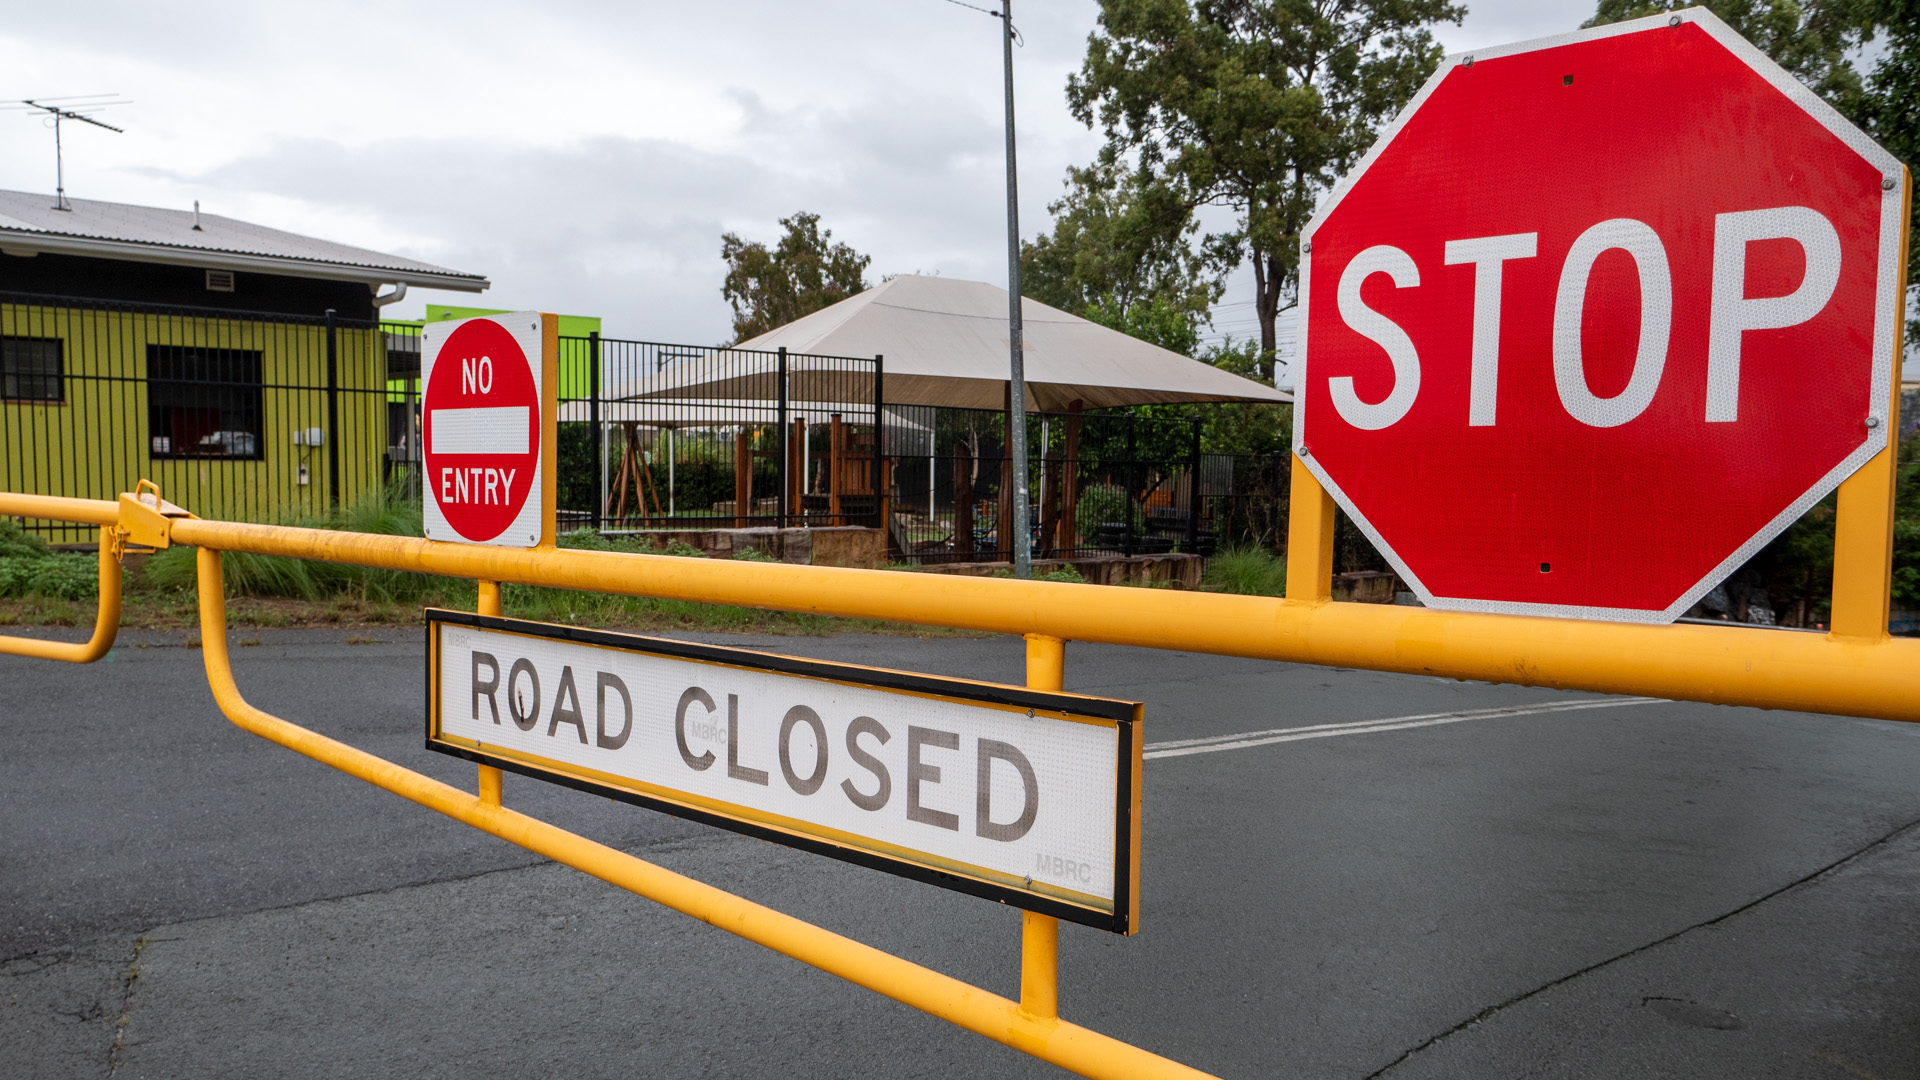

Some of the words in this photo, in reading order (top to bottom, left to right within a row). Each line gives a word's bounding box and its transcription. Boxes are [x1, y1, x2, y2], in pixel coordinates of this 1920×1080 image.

[1328, 205, 1842, 431] STOP
[462, 356, 493, 395] NO
[441, 467, 516, 506] ENTRY
[448, 632, 472, 649] MBRC
[471, 650, 633, 750] ROAD
[675, 686, 1039, 842] CLOSED
[691, 720, 727, 744] MBRC
[1036, 853, 1092, 883] MBRC
